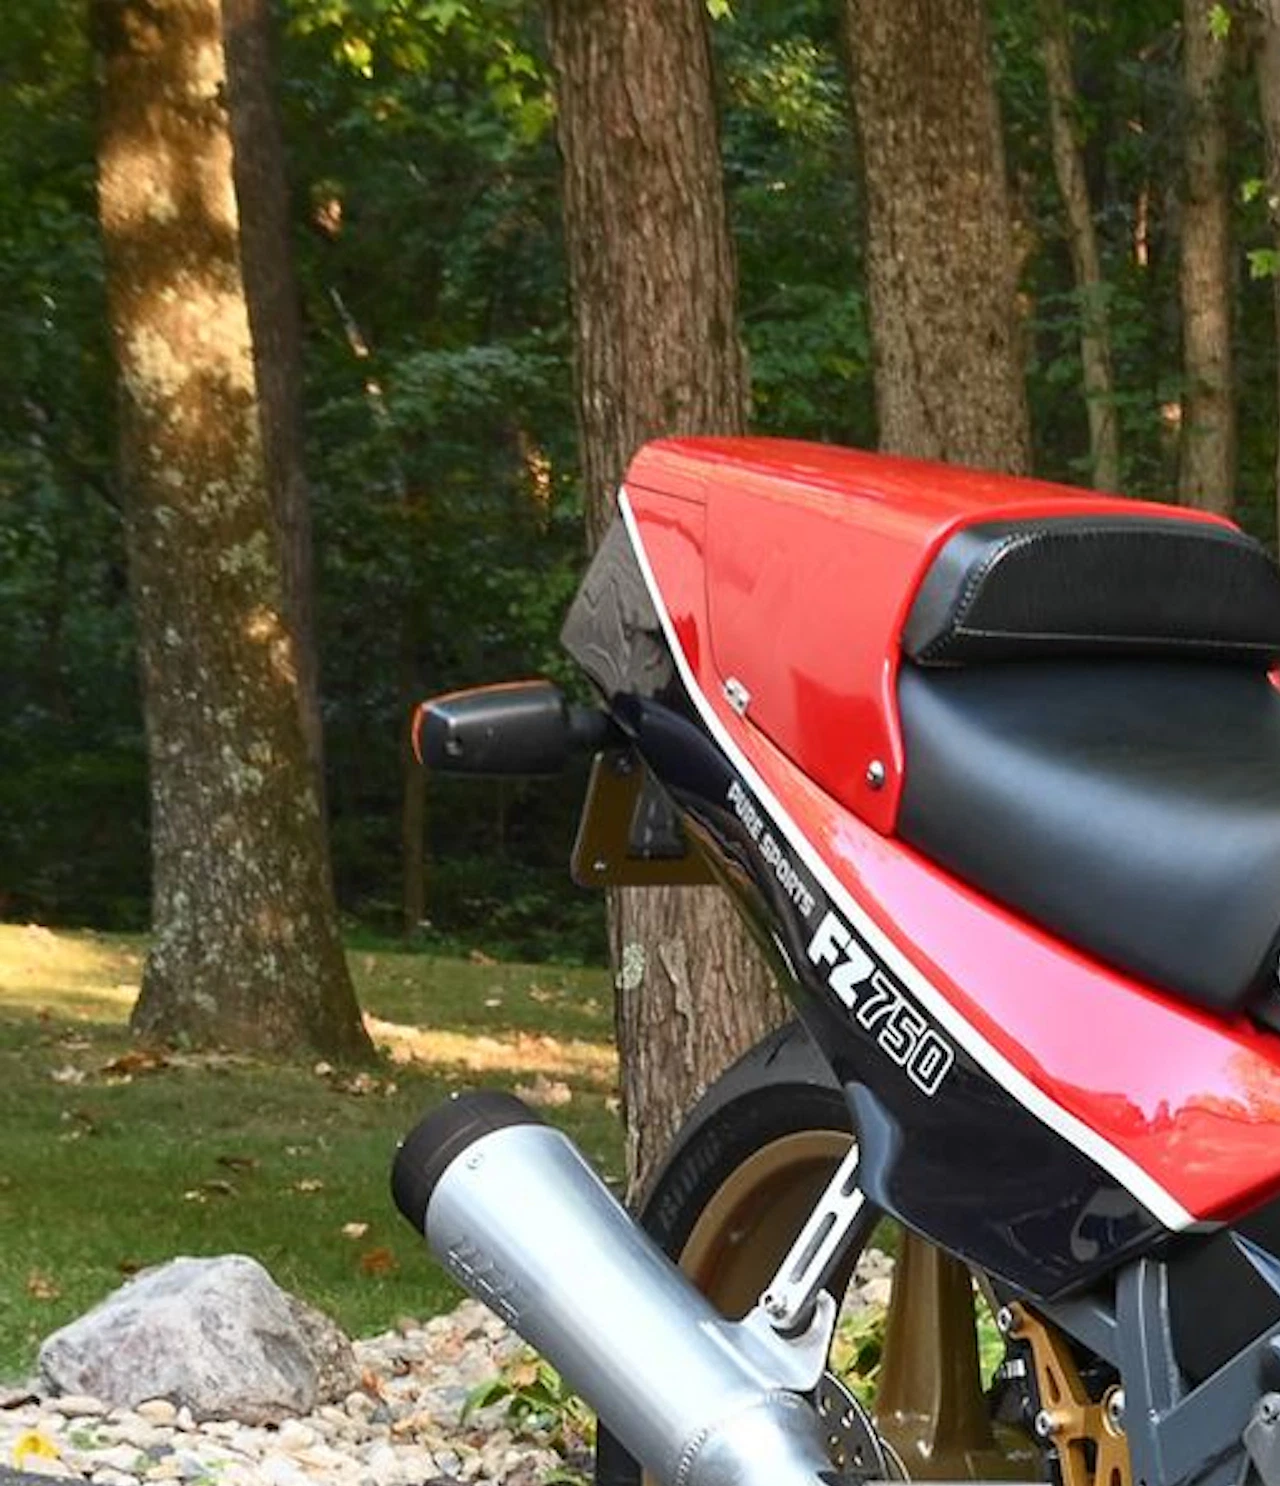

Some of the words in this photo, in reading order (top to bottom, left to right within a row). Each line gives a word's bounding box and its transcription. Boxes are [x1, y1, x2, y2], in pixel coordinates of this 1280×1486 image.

[726, 780, 763, 841] PURE
[758, 827, 817, 918] SPORTS
[806, 909, 955, 1097] FZ750
